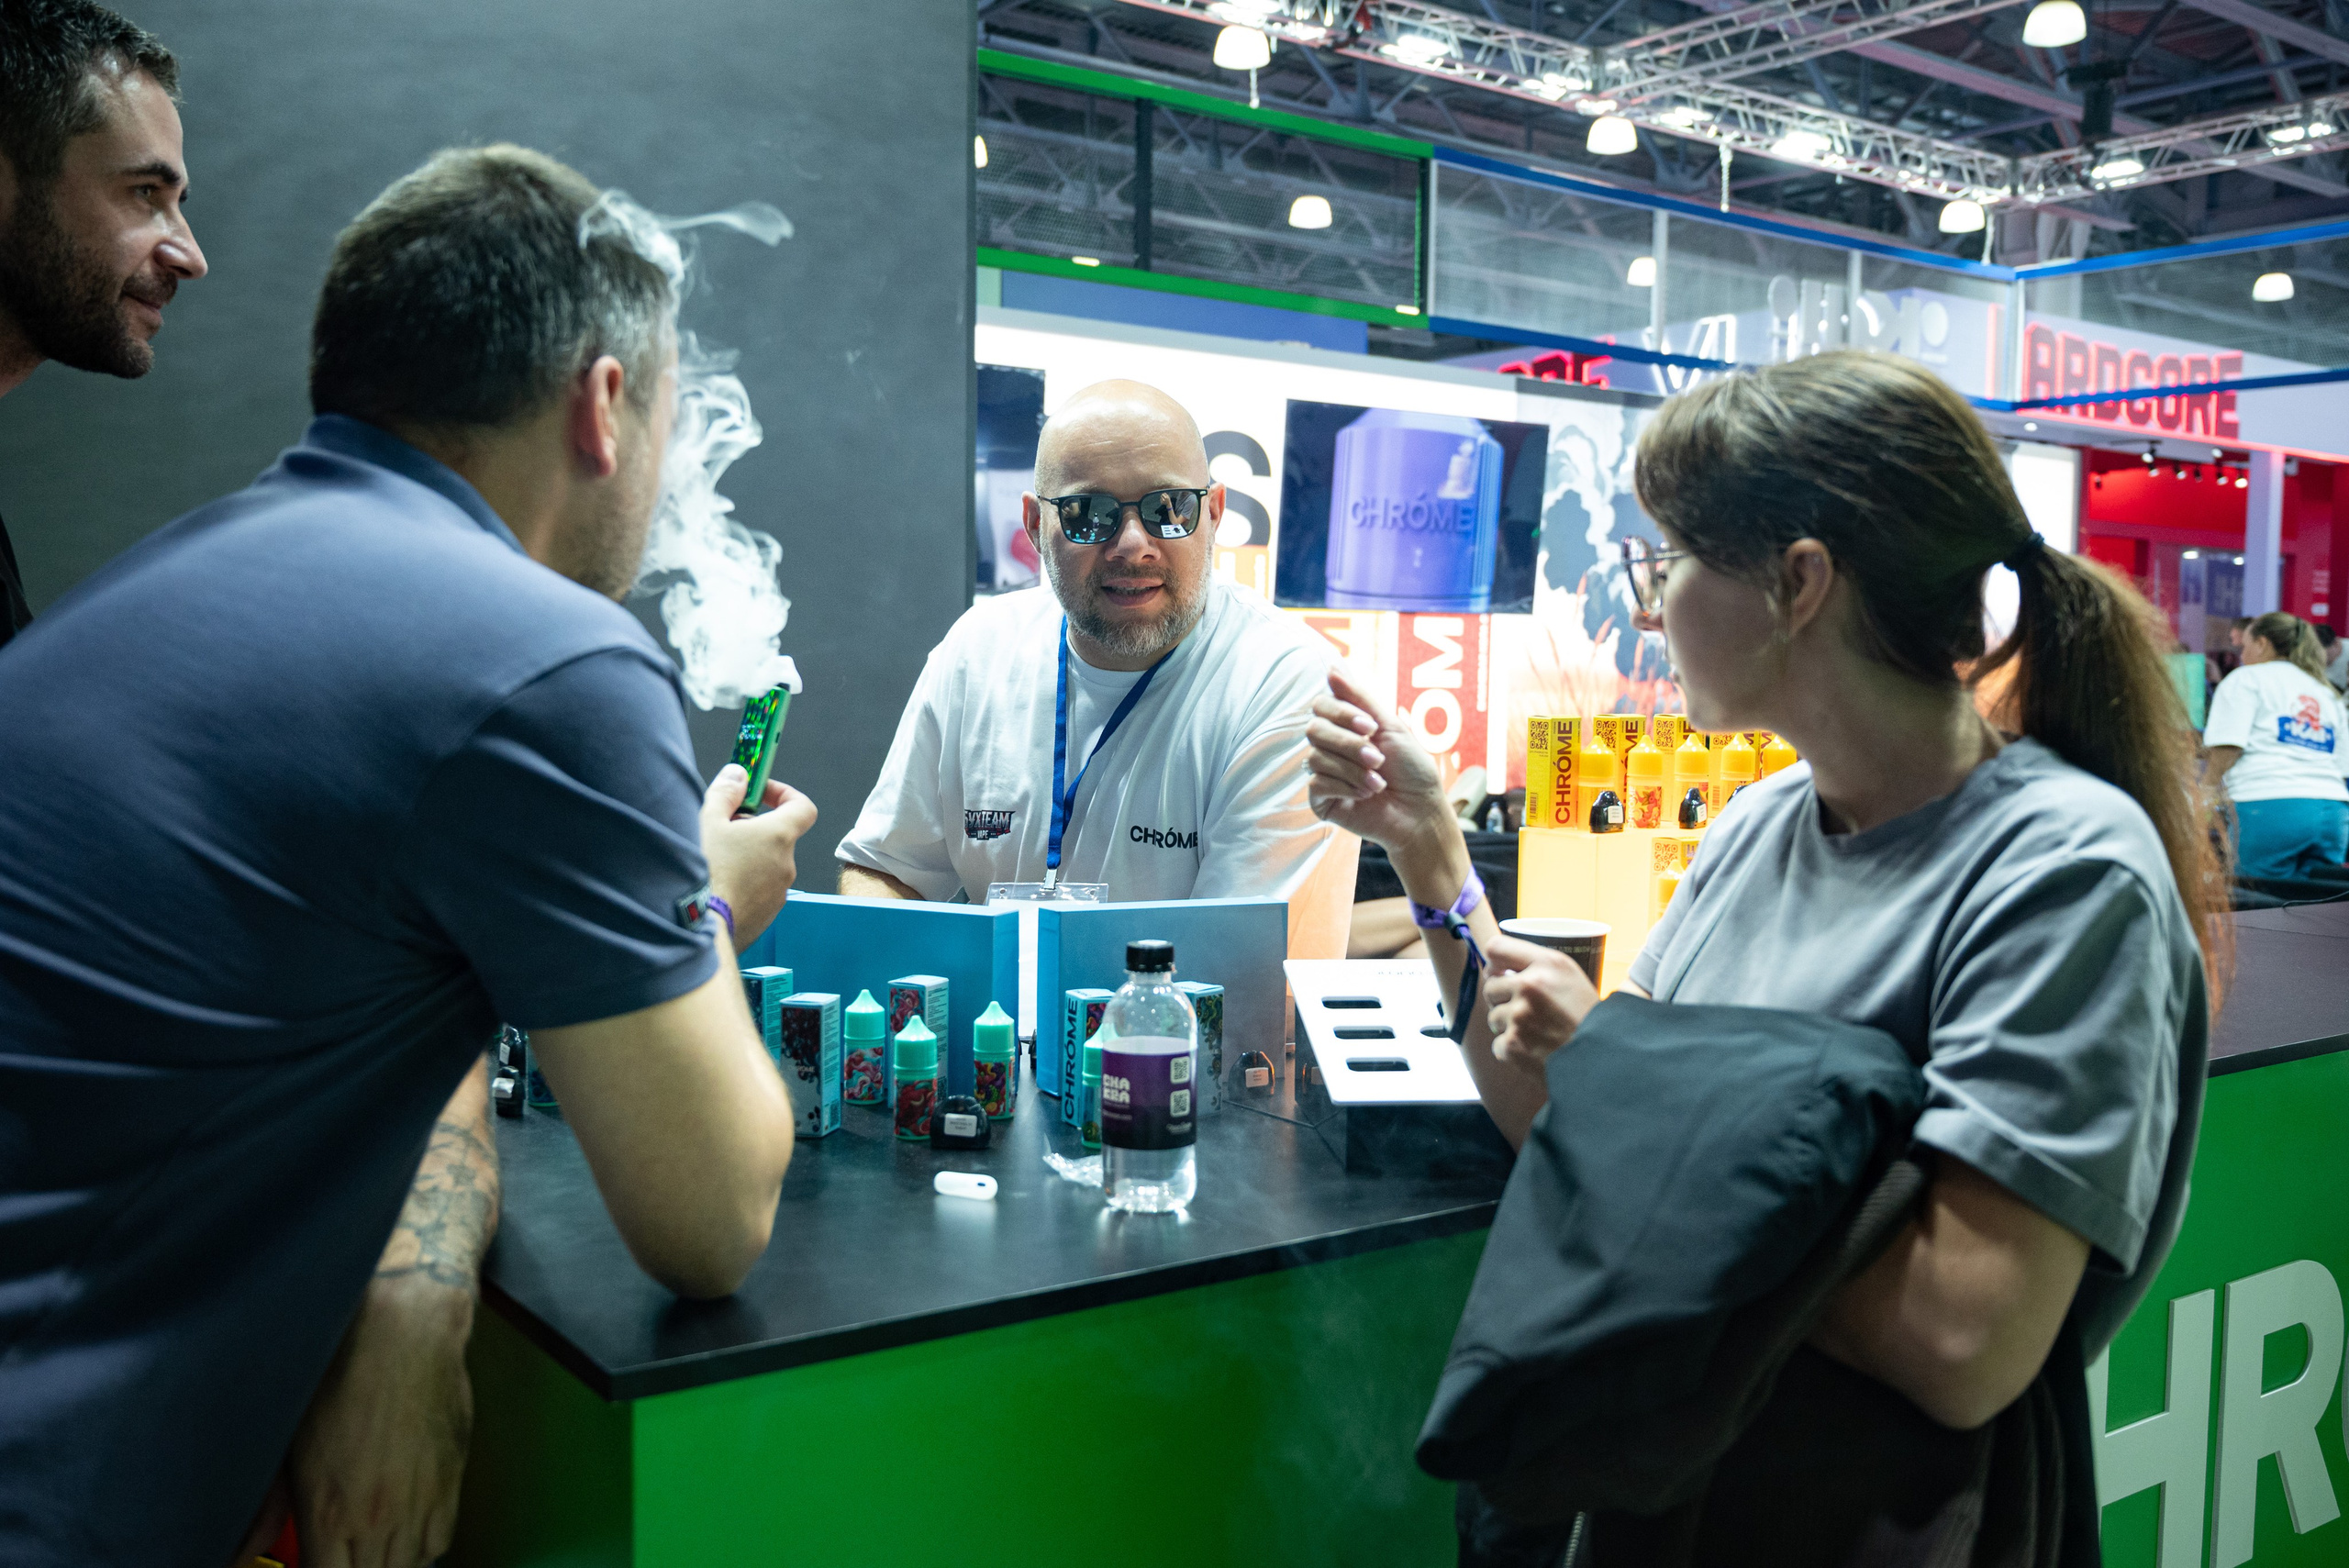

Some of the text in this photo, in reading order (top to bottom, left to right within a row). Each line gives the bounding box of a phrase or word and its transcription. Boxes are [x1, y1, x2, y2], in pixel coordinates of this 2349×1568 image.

[1352, 493, 1475, 535] CHRÓME
[1553, 721, 1572, 824] CHRÓME
[1130, 825, 1198, 849] CHRÓME
[1064, 998, 1078, 1119] CHRÓME
[2085, 1259, 2349, 1568] HR
